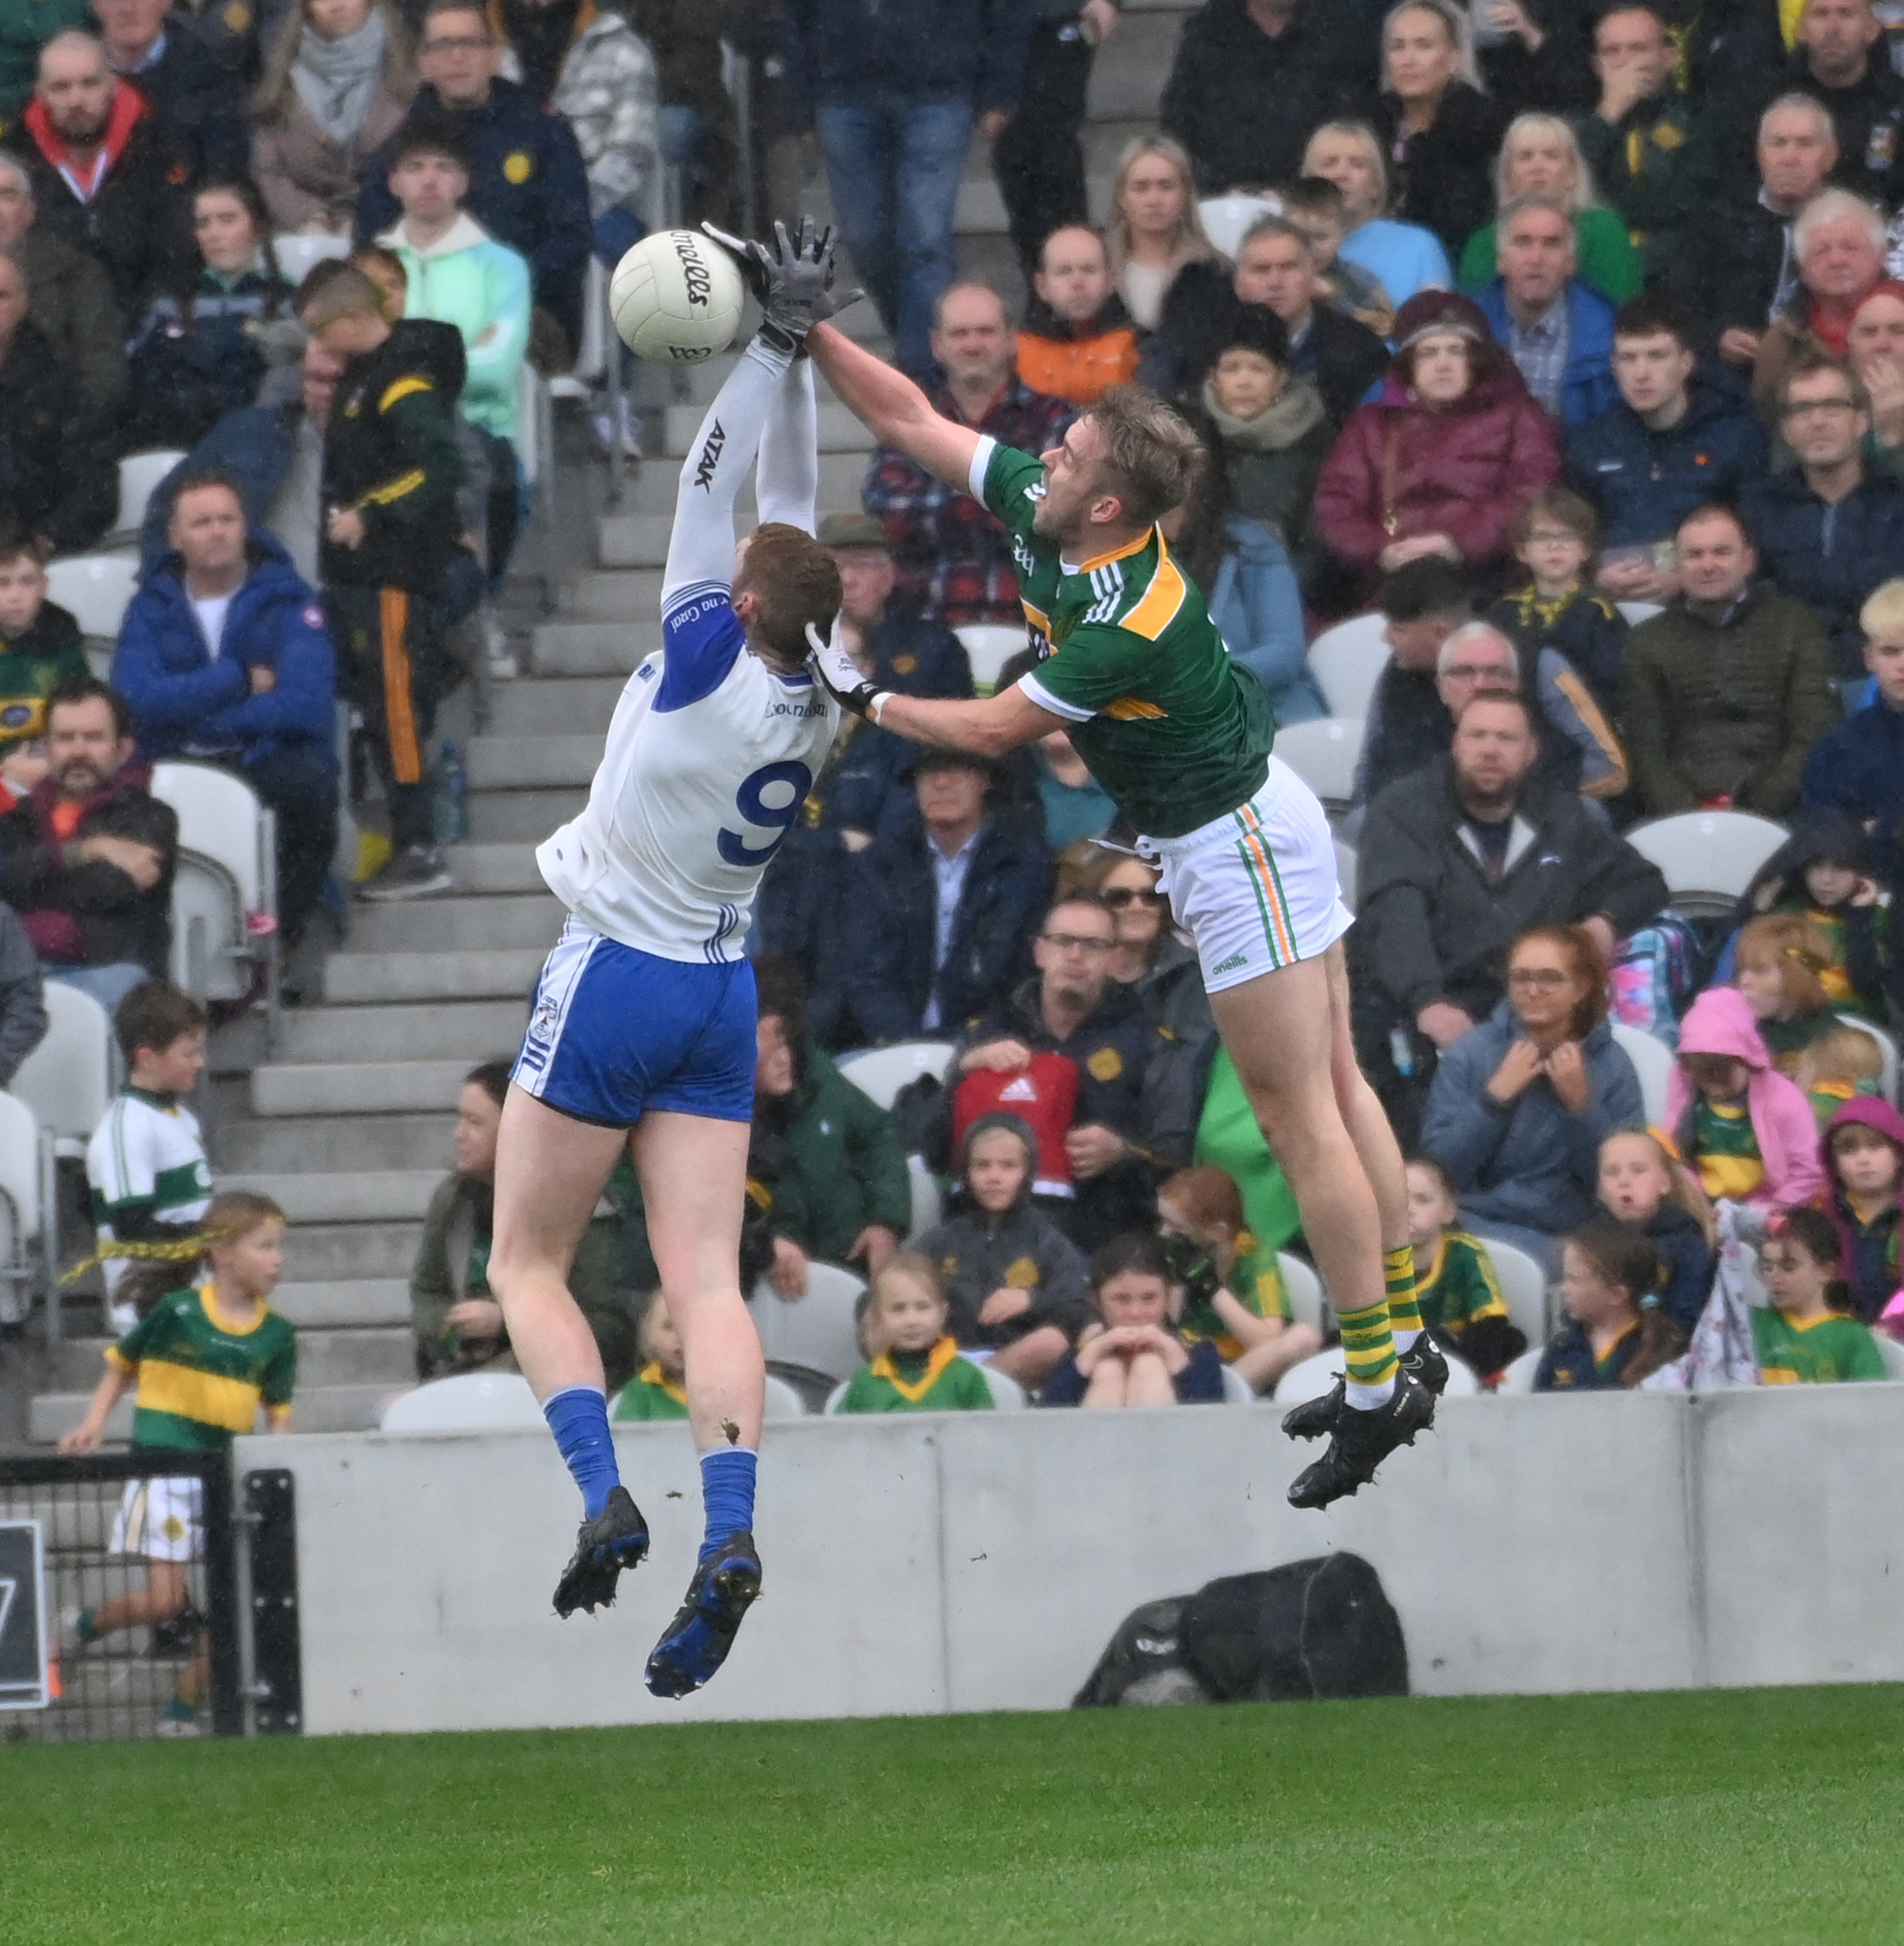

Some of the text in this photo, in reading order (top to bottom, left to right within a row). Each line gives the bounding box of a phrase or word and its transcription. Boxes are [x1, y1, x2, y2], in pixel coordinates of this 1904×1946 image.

[694, 416, 726, 494] ATAK
[716, 760, 812, 866] 9
[1212, 955, 1248, 976] oneills
